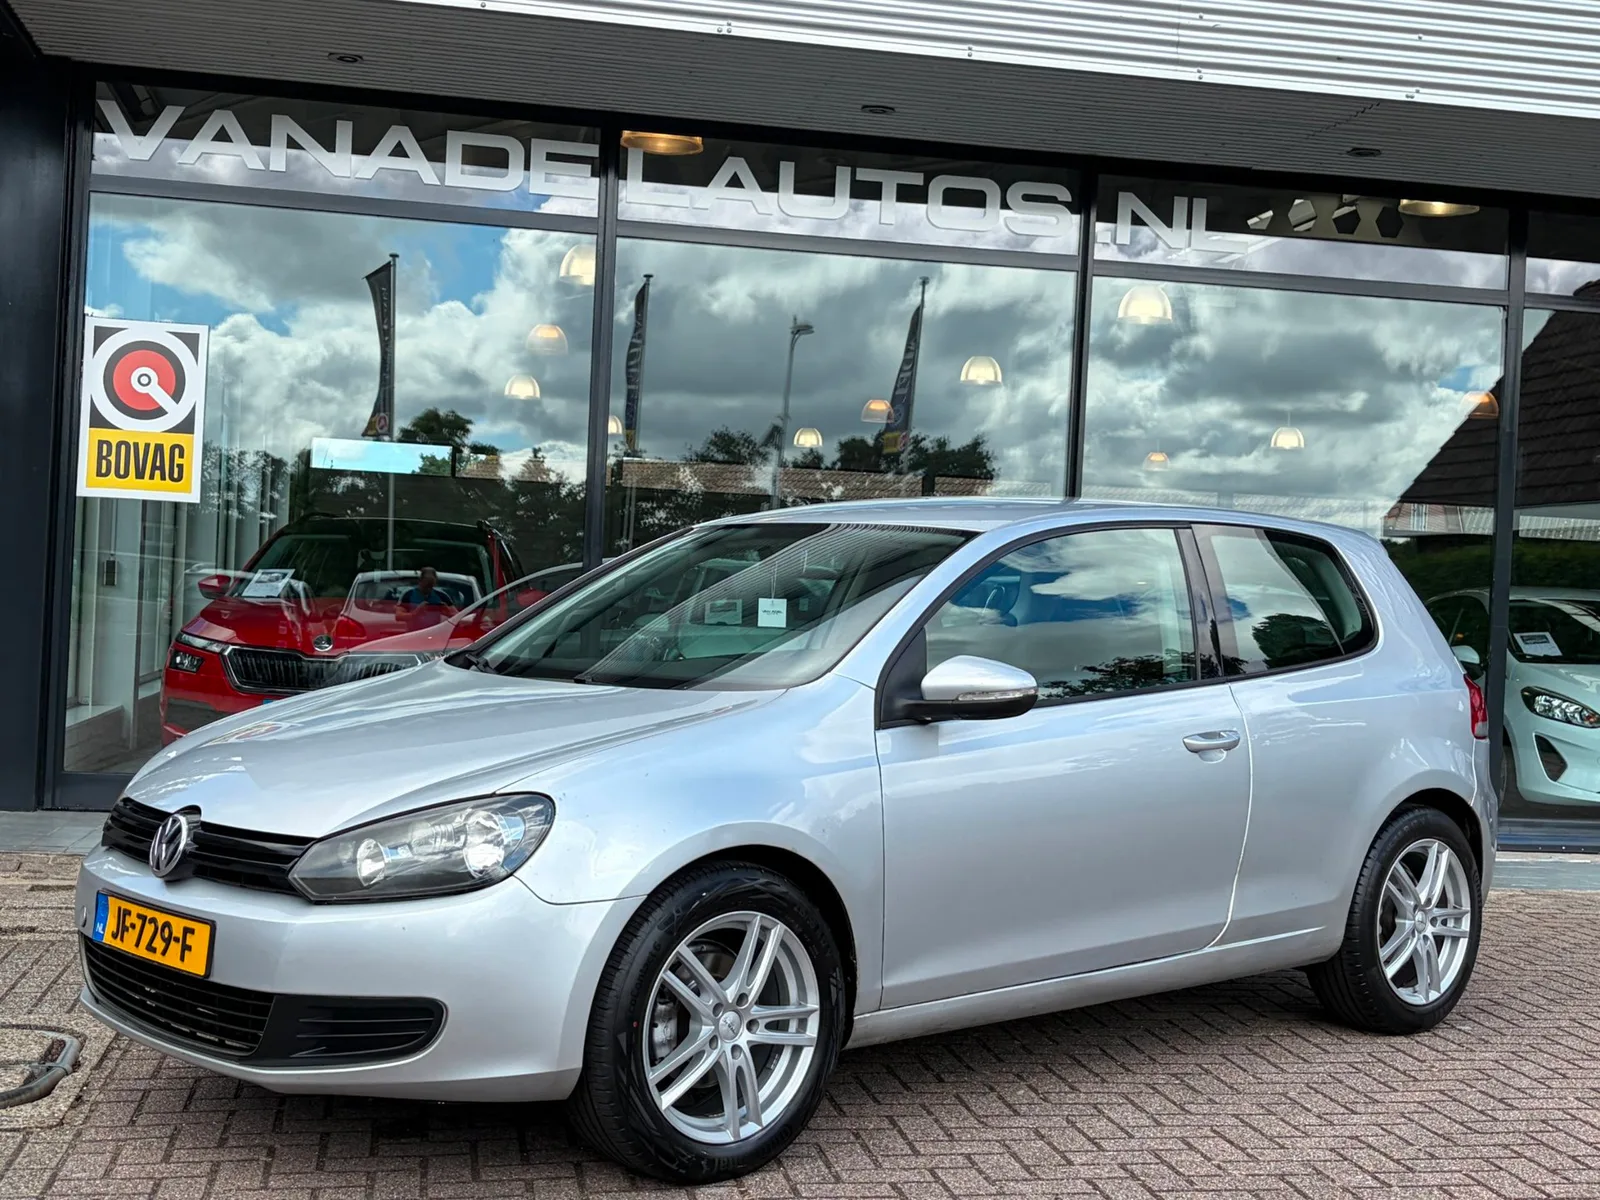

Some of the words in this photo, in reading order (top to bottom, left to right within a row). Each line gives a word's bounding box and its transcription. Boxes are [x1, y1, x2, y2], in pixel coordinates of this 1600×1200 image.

[96, 439, 185, 483] BOVAG
[96, 922, 104, 934] NL
[111, 905, 196, 963] JF-729-F
